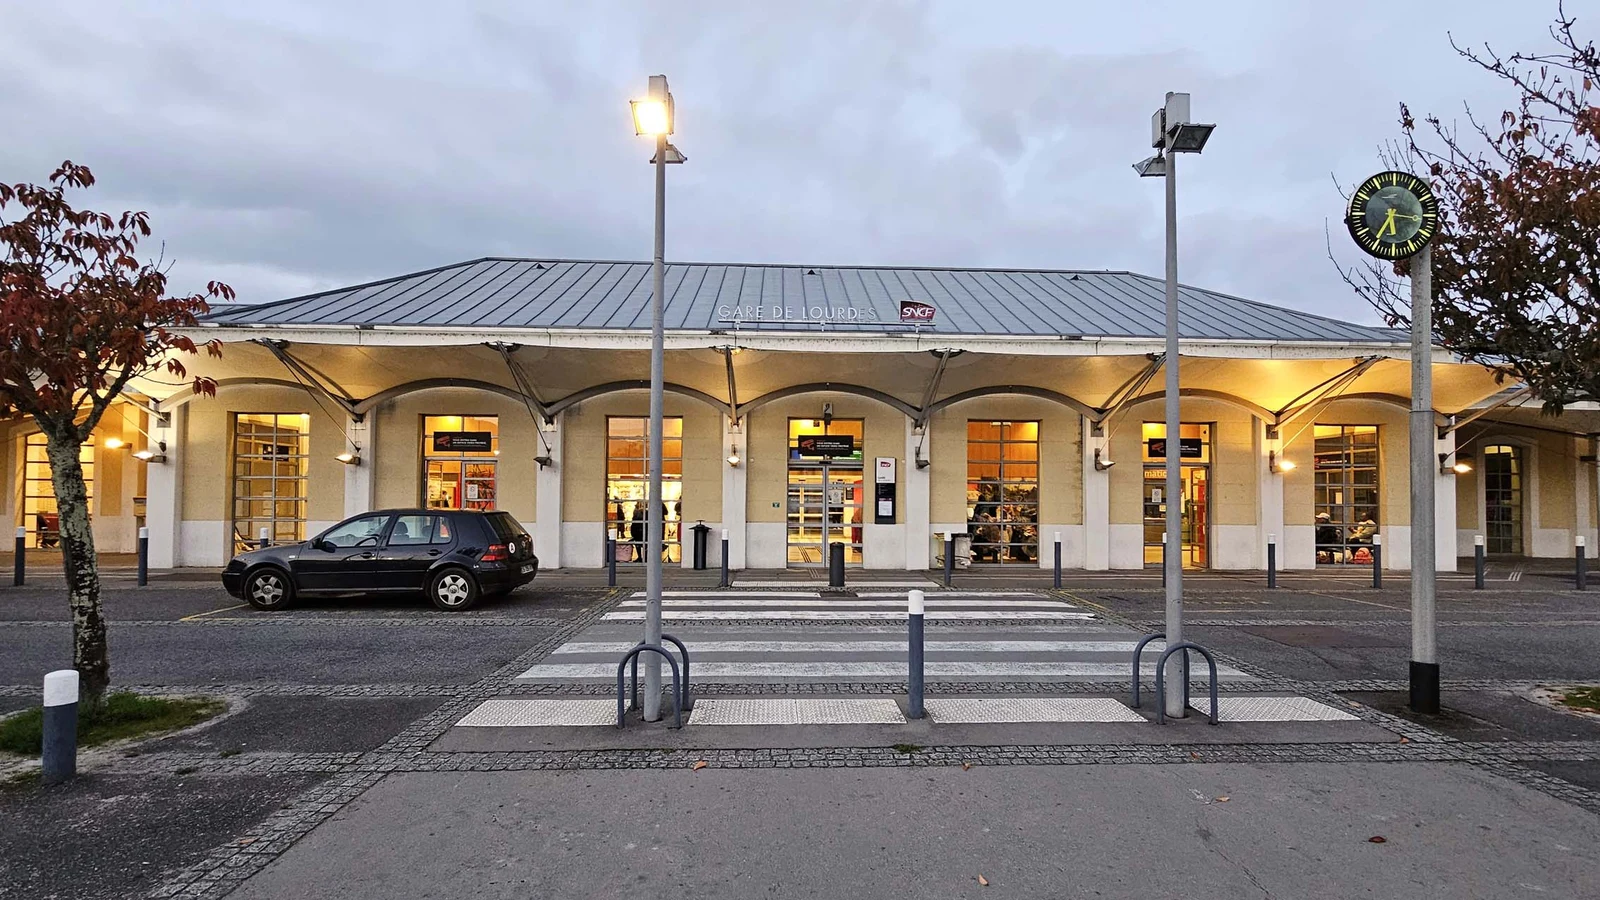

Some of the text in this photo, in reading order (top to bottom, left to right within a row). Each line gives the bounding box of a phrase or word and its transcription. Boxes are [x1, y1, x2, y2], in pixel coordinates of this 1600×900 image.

[717, 305, 876, 320] GARE DE LOURDES
[902, 307, 934, 317] SNCF
